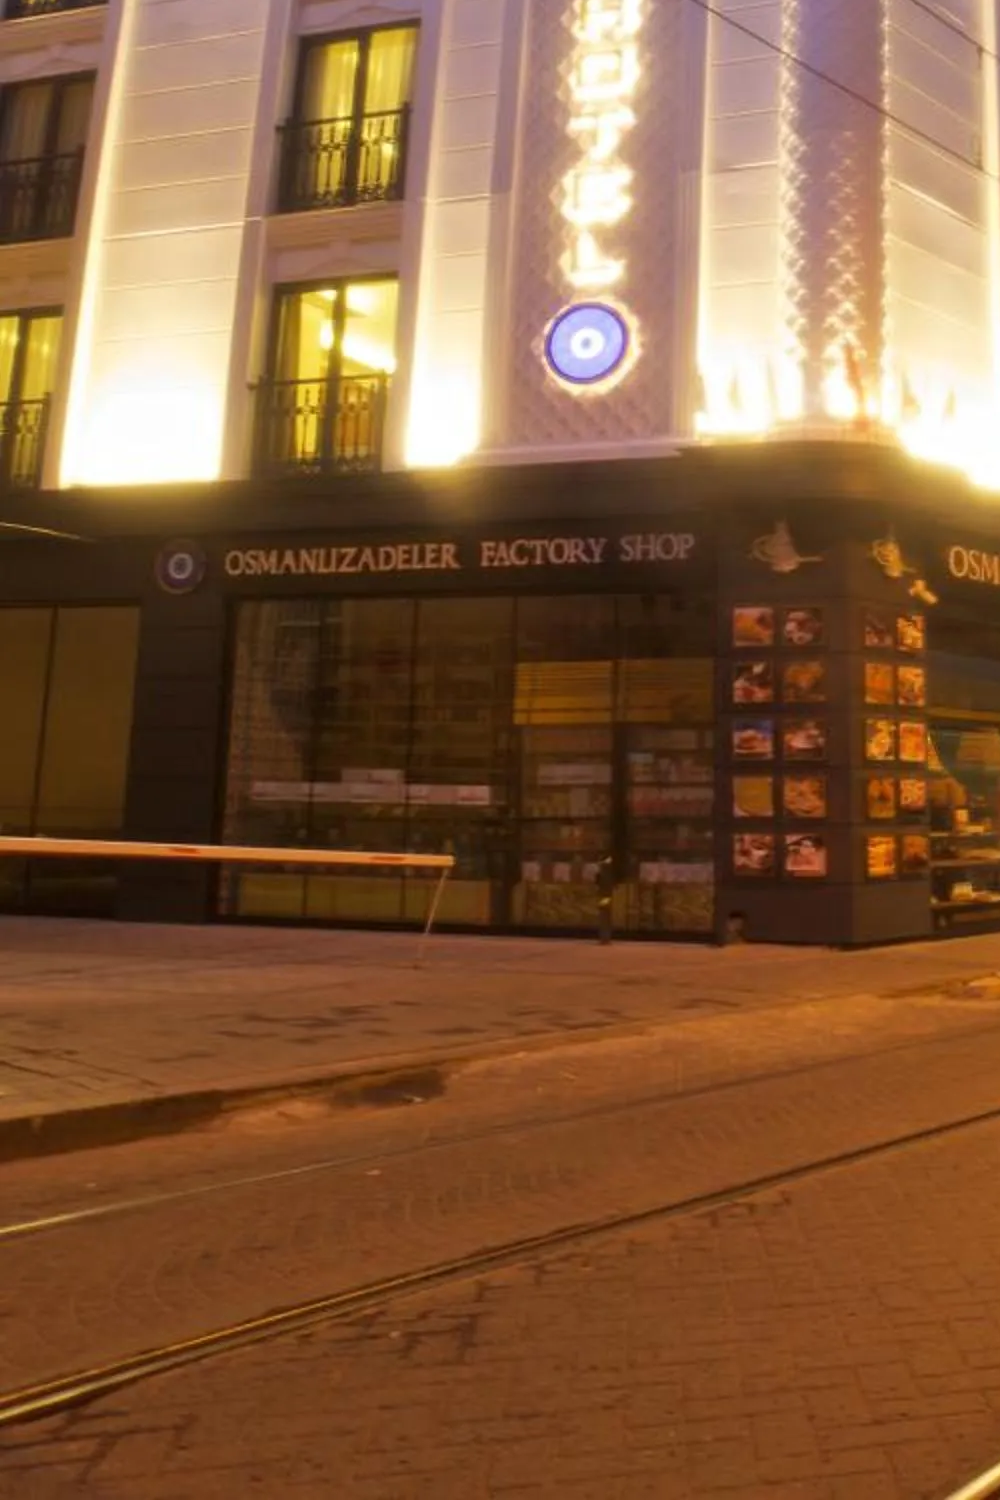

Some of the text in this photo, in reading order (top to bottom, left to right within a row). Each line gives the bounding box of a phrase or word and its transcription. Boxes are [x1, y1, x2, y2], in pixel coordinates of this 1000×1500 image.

[224, 533, 695, 575] OSMANLIZADELER FACTORY SHOP
